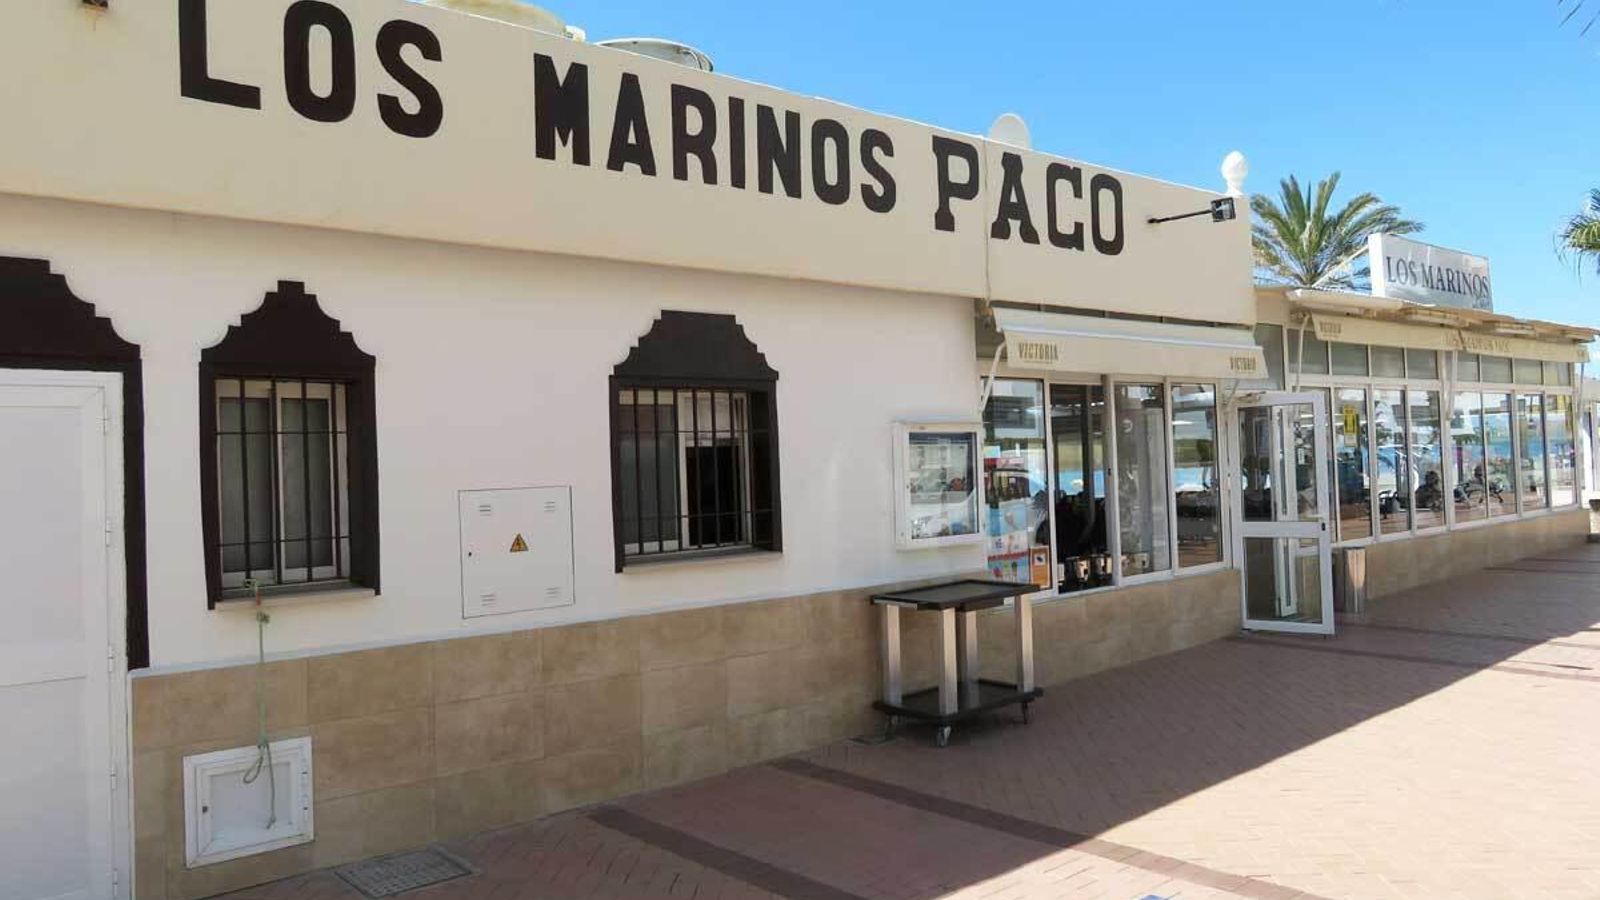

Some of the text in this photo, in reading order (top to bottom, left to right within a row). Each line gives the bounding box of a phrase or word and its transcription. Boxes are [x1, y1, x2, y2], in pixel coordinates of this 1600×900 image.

[178, 0, 1125, 256] LOS MARINOS PACO
[1386, 256, 1489, 298] LOS MARINOS
[1019, 343, 1059, 360] VICTORIA
